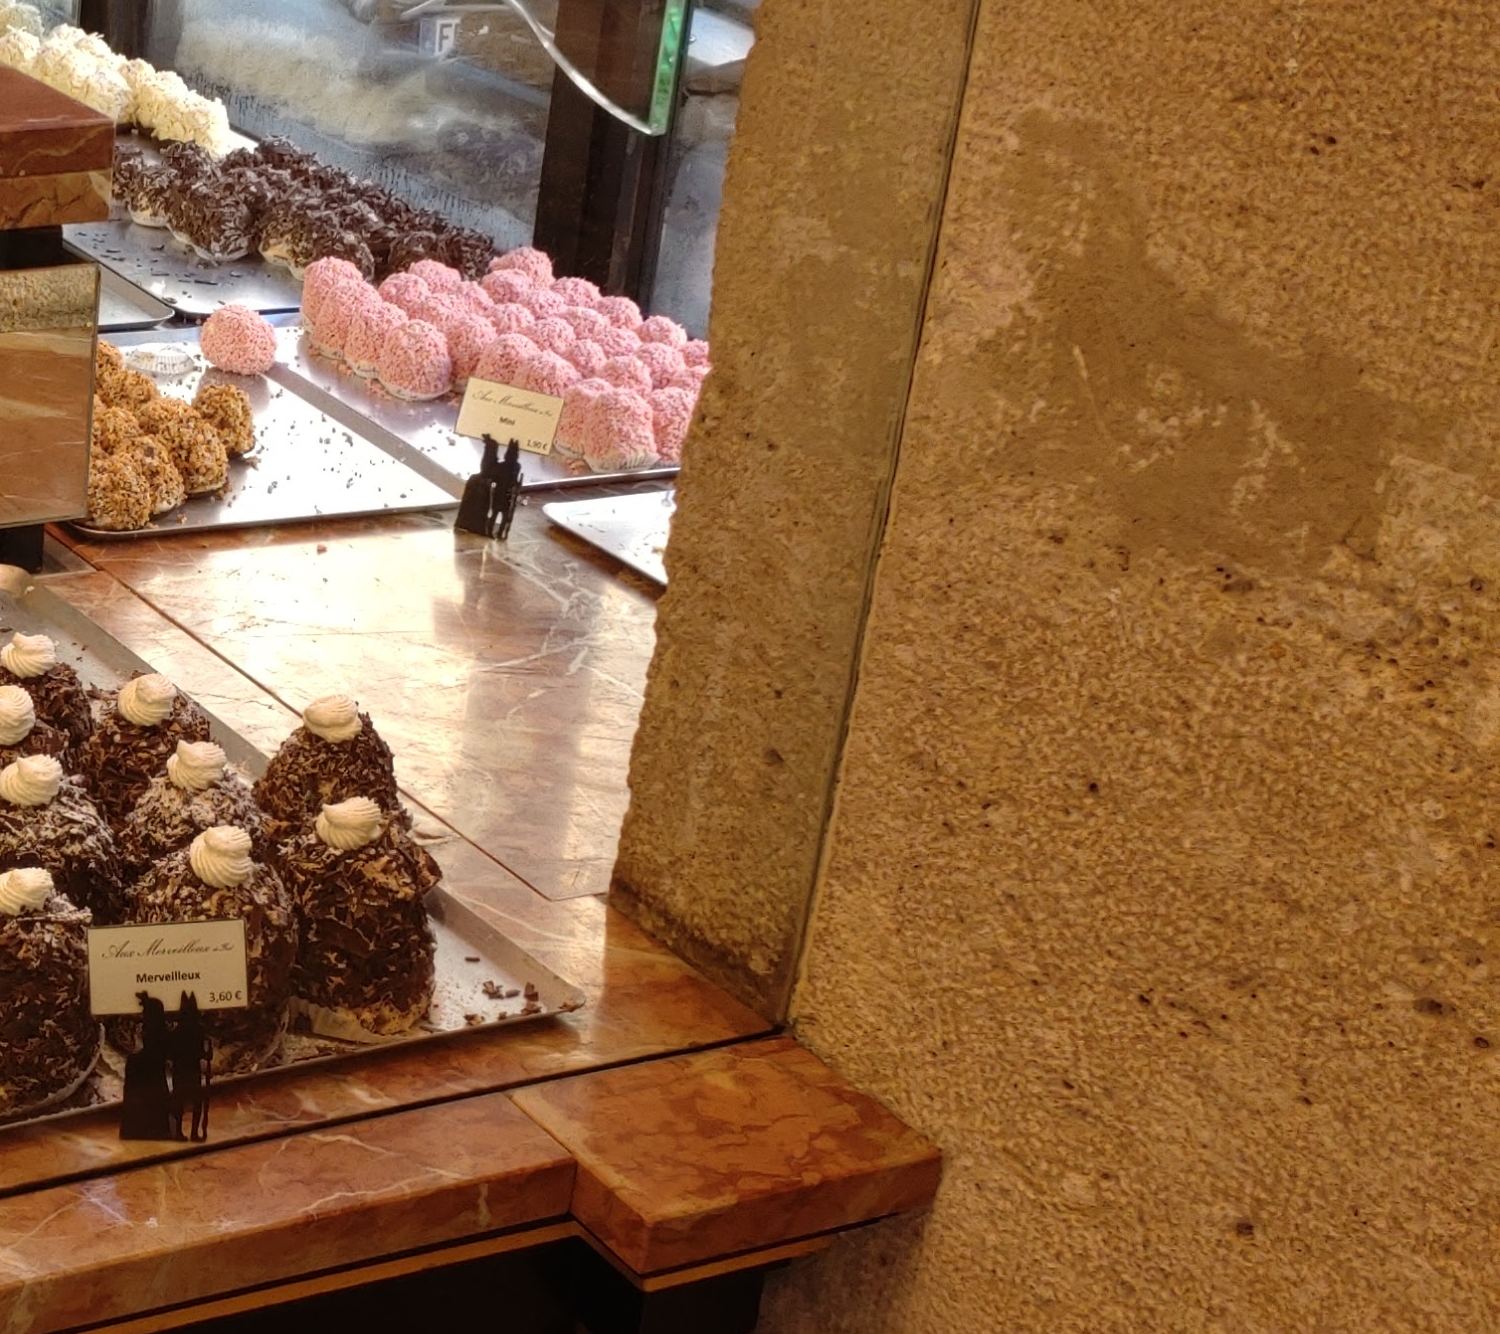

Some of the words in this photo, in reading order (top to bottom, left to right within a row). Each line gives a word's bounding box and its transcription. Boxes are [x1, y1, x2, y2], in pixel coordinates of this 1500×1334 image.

[102, 940, 135, 958] Aux
[137, 938, 211, 957] Merveilleux
[136, 971, 201, 983] Merveilleux
[209, 991, 233, 1004] 3,60
[235, 990, 243, 1001] €
